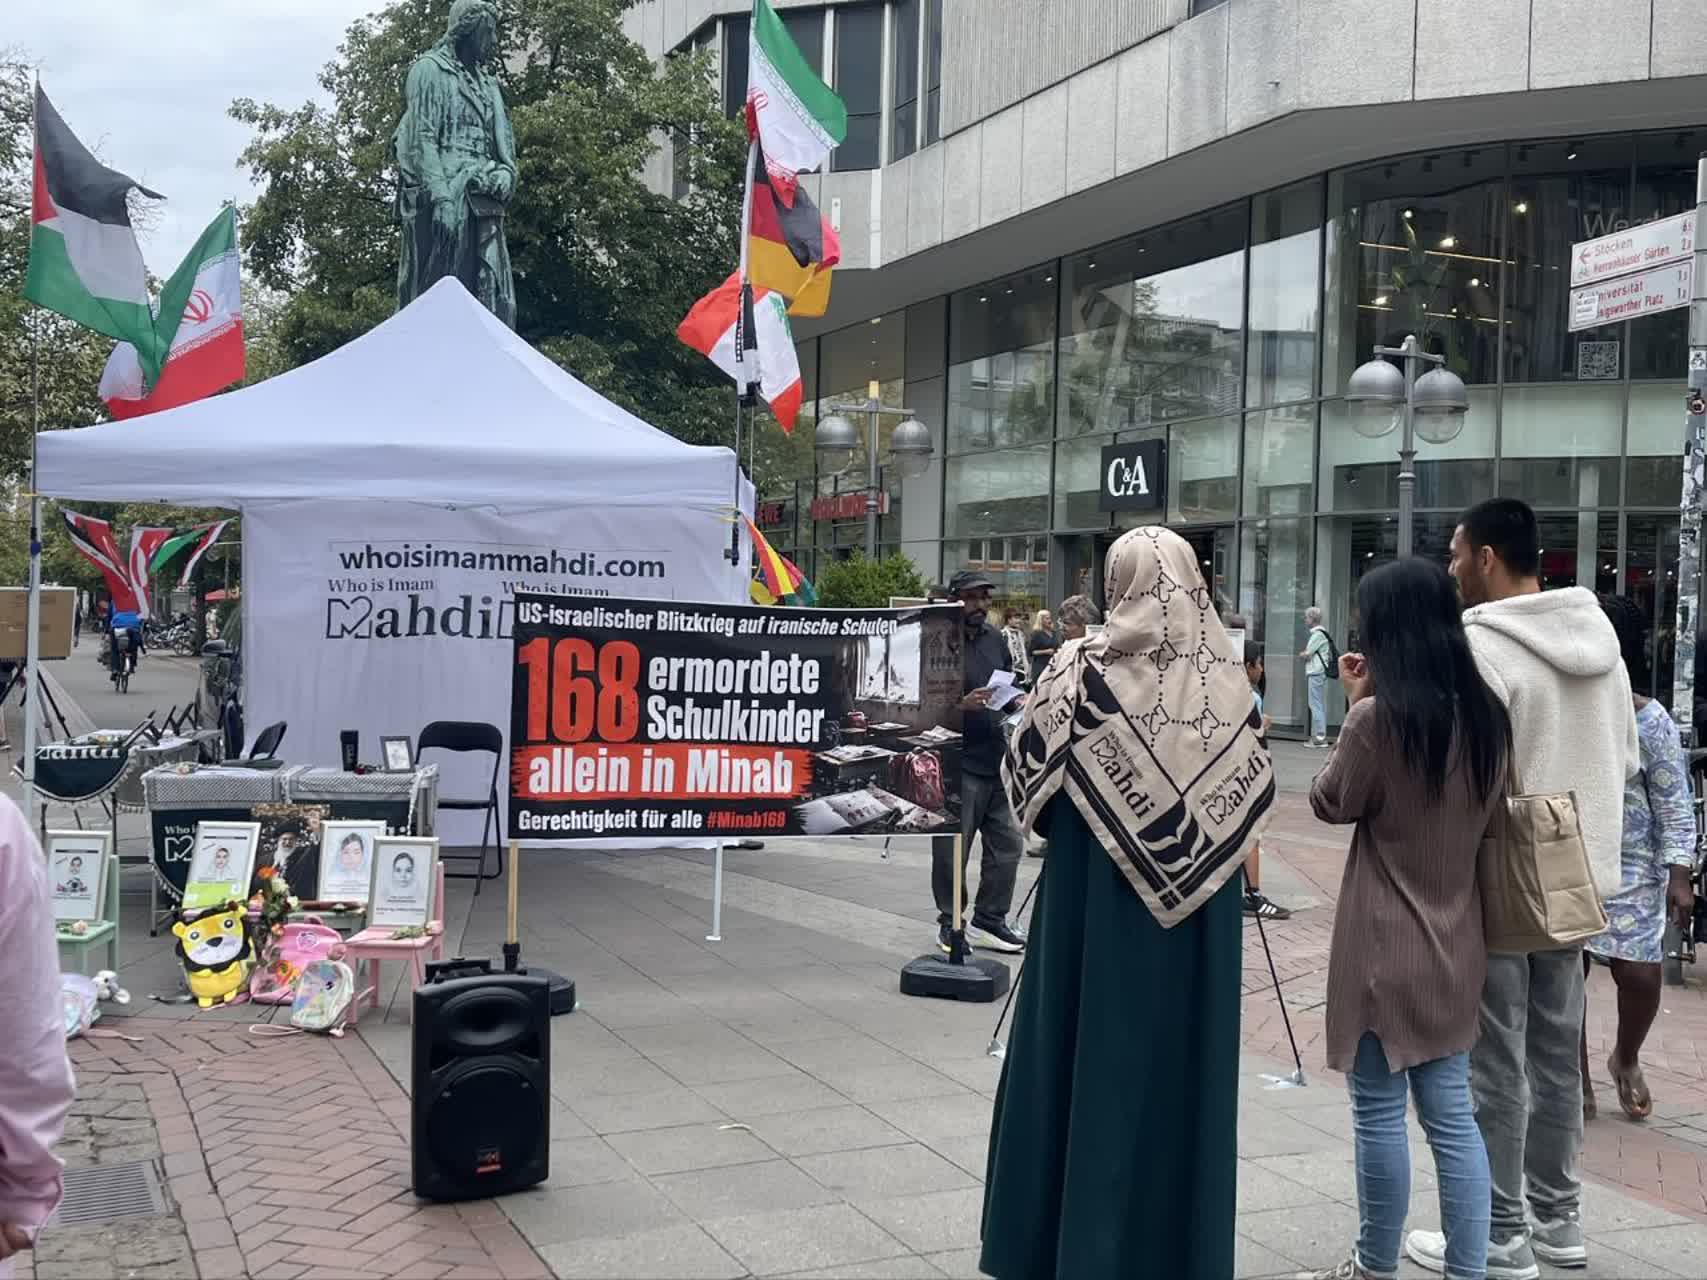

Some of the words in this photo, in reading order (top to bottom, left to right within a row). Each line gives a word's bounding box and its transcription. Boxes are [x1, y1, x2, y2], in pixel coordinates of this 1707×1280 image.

[1108, 455, 1150, 497] C&A
[339, 543, 665, 578] whoisimammahdi.com
[328, 578, 368, 593] Who
[371, 578, 385, 592] is
[388, 578, 435, 592] Imam
[326, 593, 494, 639] Mahdi
[518, 601, 654, 631] US-israelischer
[656, 609, 736, 638] Blitzkrieg
[738, 615, 767, 635] auf
[767, 616, 839, 636] iranische
[840, 617, 898, 637] Schulen
[518, 637, 641, 743] 168
[648, 650, 820, 695] ermordete
[647, 696, 825, 743] Schulkinder
[529, 747, 630, 794] allein
[642, 748, 674, 793] in
[686, 750, 793, 794] Minab
[1089, 736, 1155, 819] Mahdi
[1206, 750, 1265, 826] Mahdi
[164, 826, 190, 834] Who
[518, 809, 637, 833] Gerechtigkeit
[641, 810, 668, 828] für
[671, 811, 702, 829] alle
[706, 810, 787, 829] #Minab168
